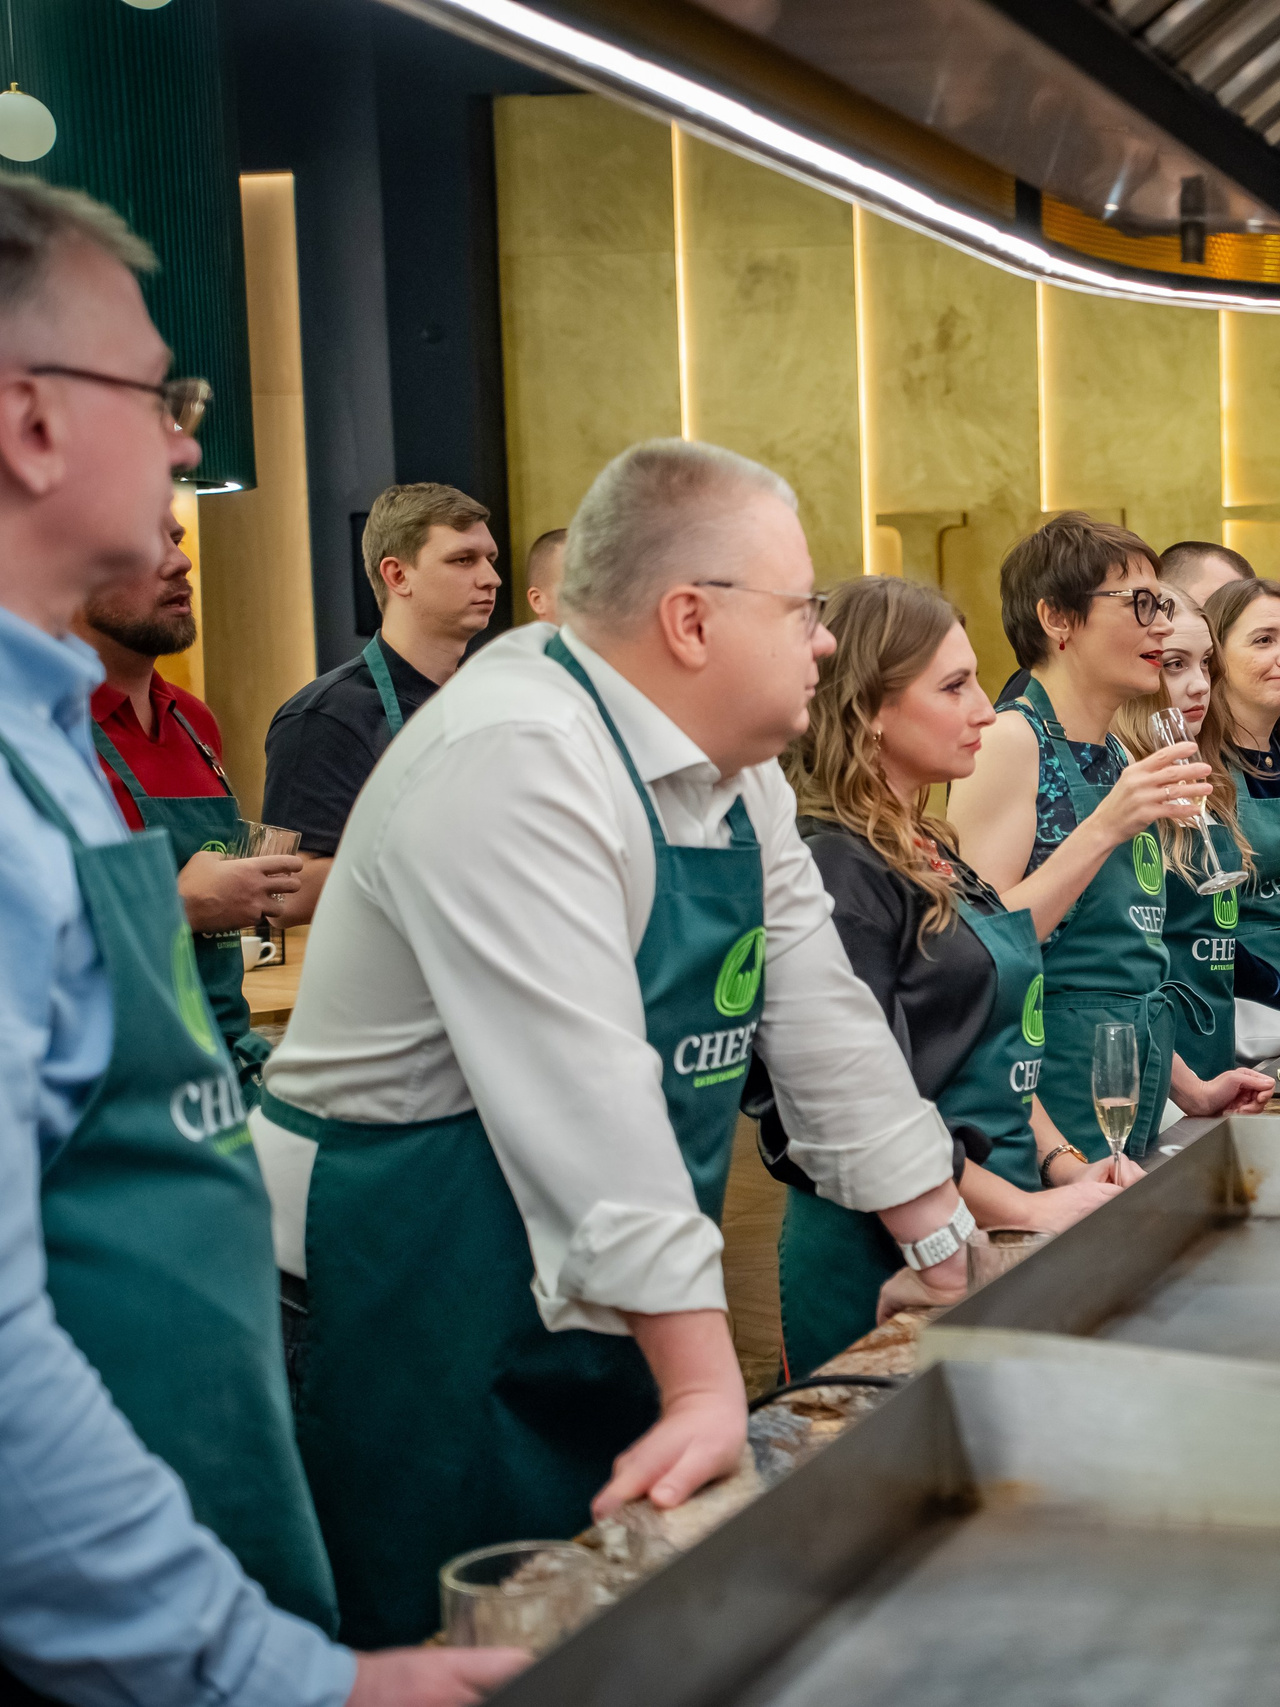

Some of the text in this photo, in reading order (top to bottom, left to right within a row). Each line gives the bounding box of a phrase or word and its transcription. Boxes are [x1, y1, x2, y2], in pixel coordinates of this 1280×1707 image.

[1191, 938, 1236, 961] CHE
[673, 1021, 758, 1075] CHEF
[1010, 1059, 1042, 1092] CH
